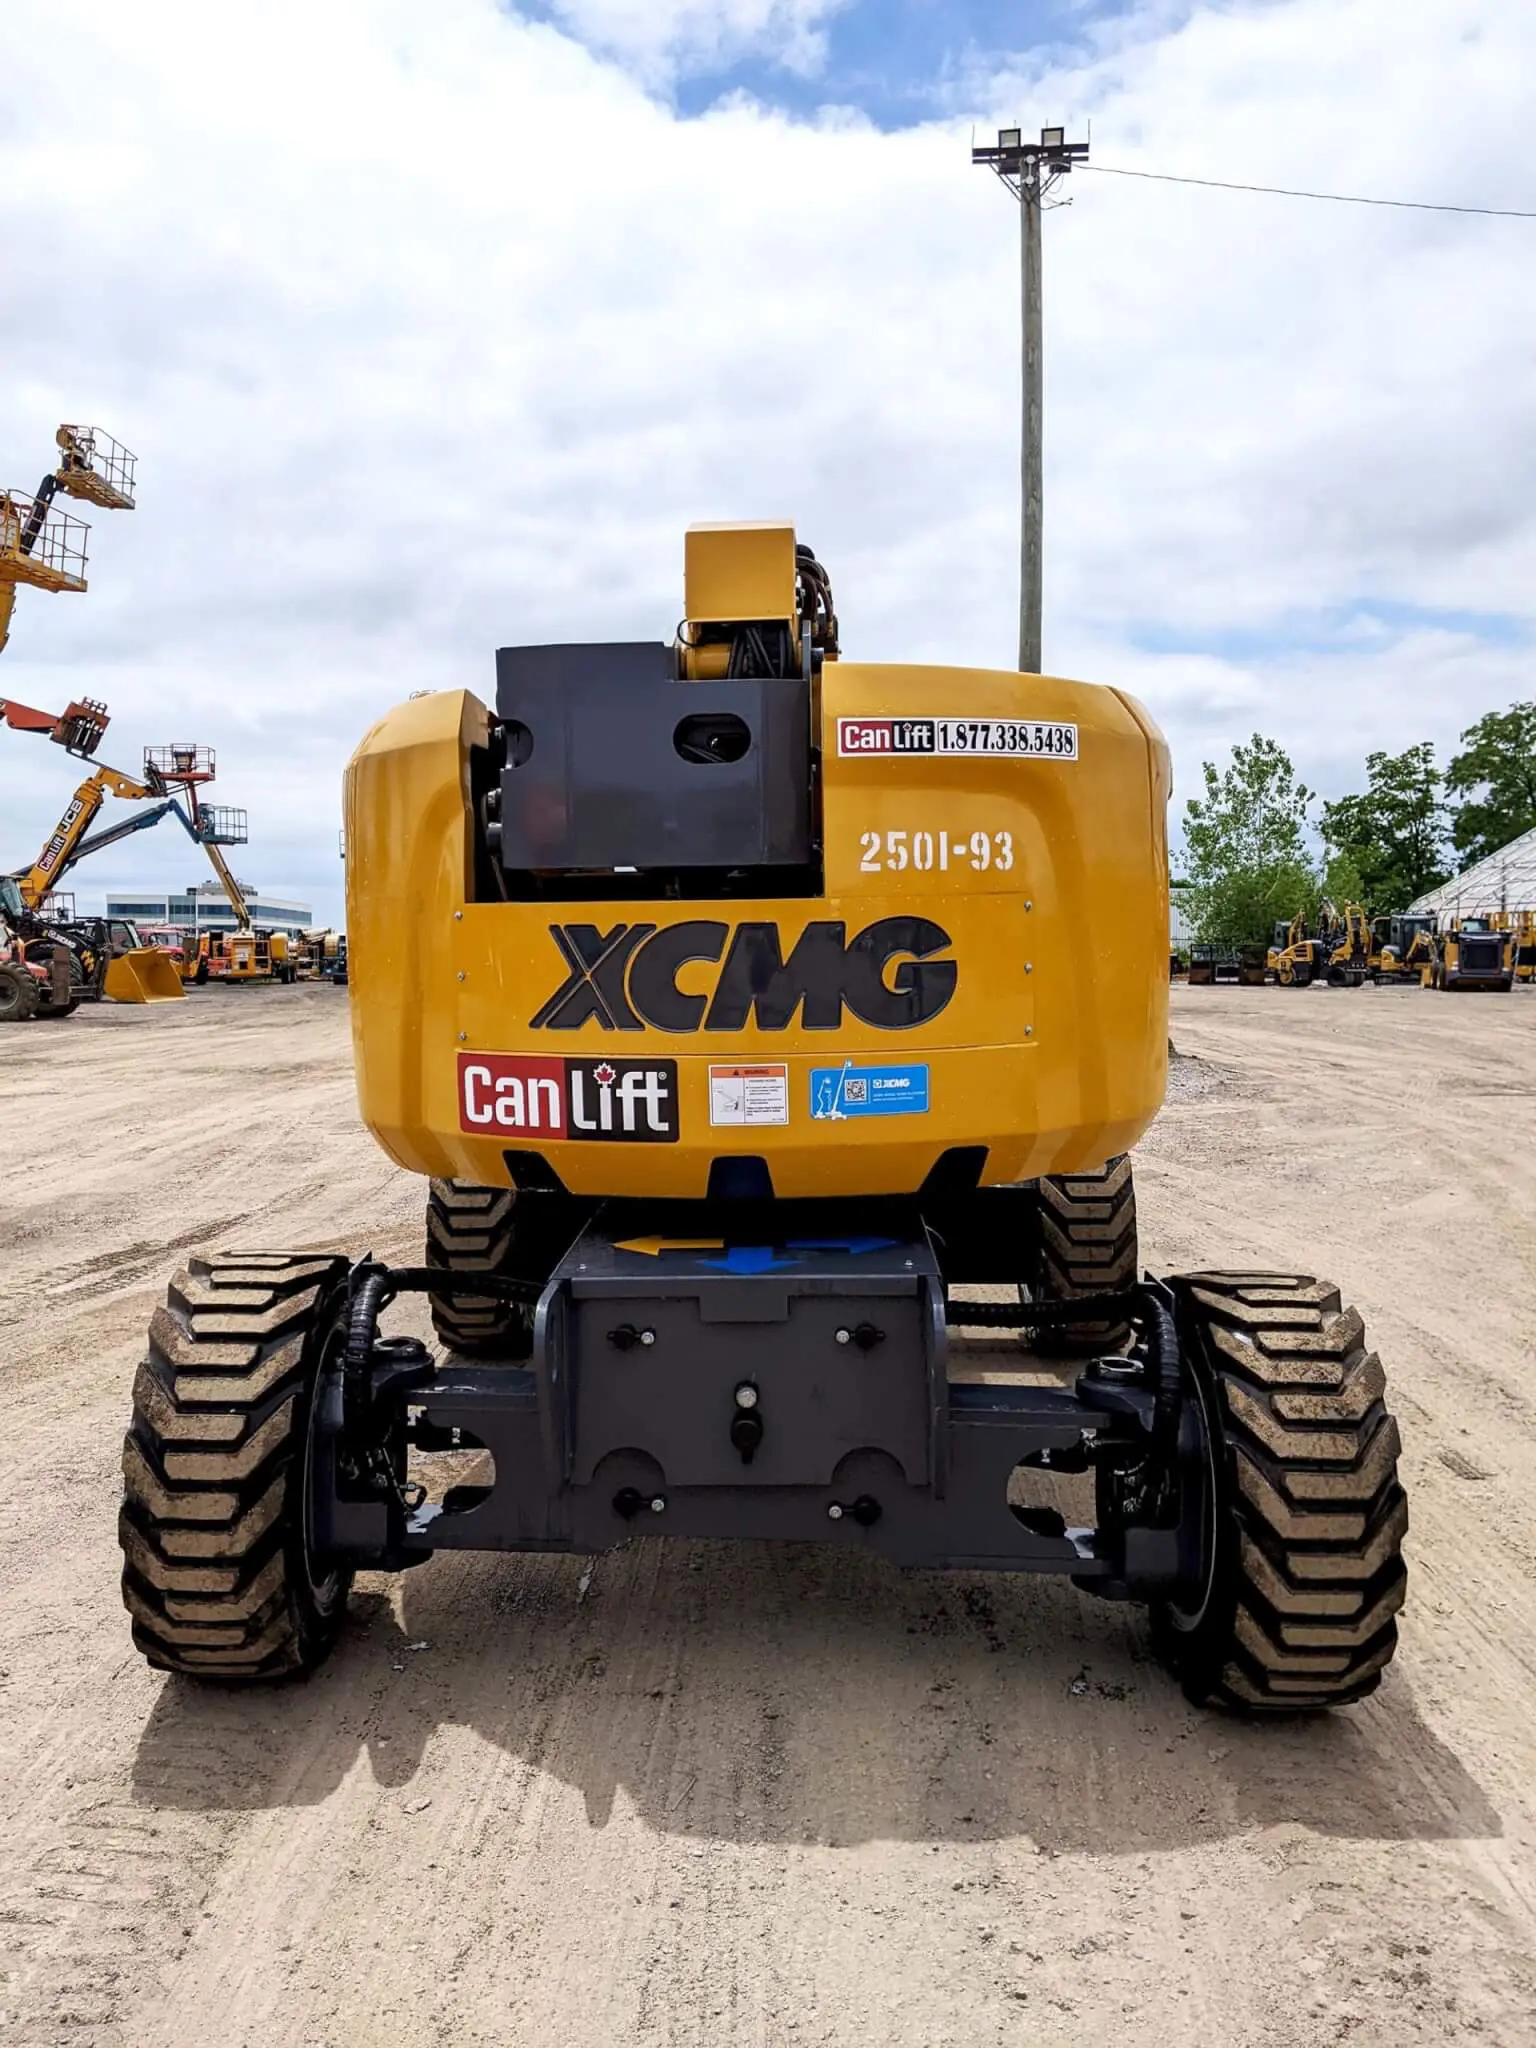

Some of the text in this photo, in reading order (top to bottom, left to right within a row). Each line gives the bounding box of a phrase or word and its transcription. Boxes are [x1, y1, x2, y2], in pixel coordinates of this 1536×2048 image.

[940, 724, 1073, 753] 1.877.338.5438
[61, 800, 84, 833] JCB
[860, 832, 1014, 871] 2501-93
[528, 916, 957, 1033] XCMG
[883, 1078, 911, 1088] XCMG
